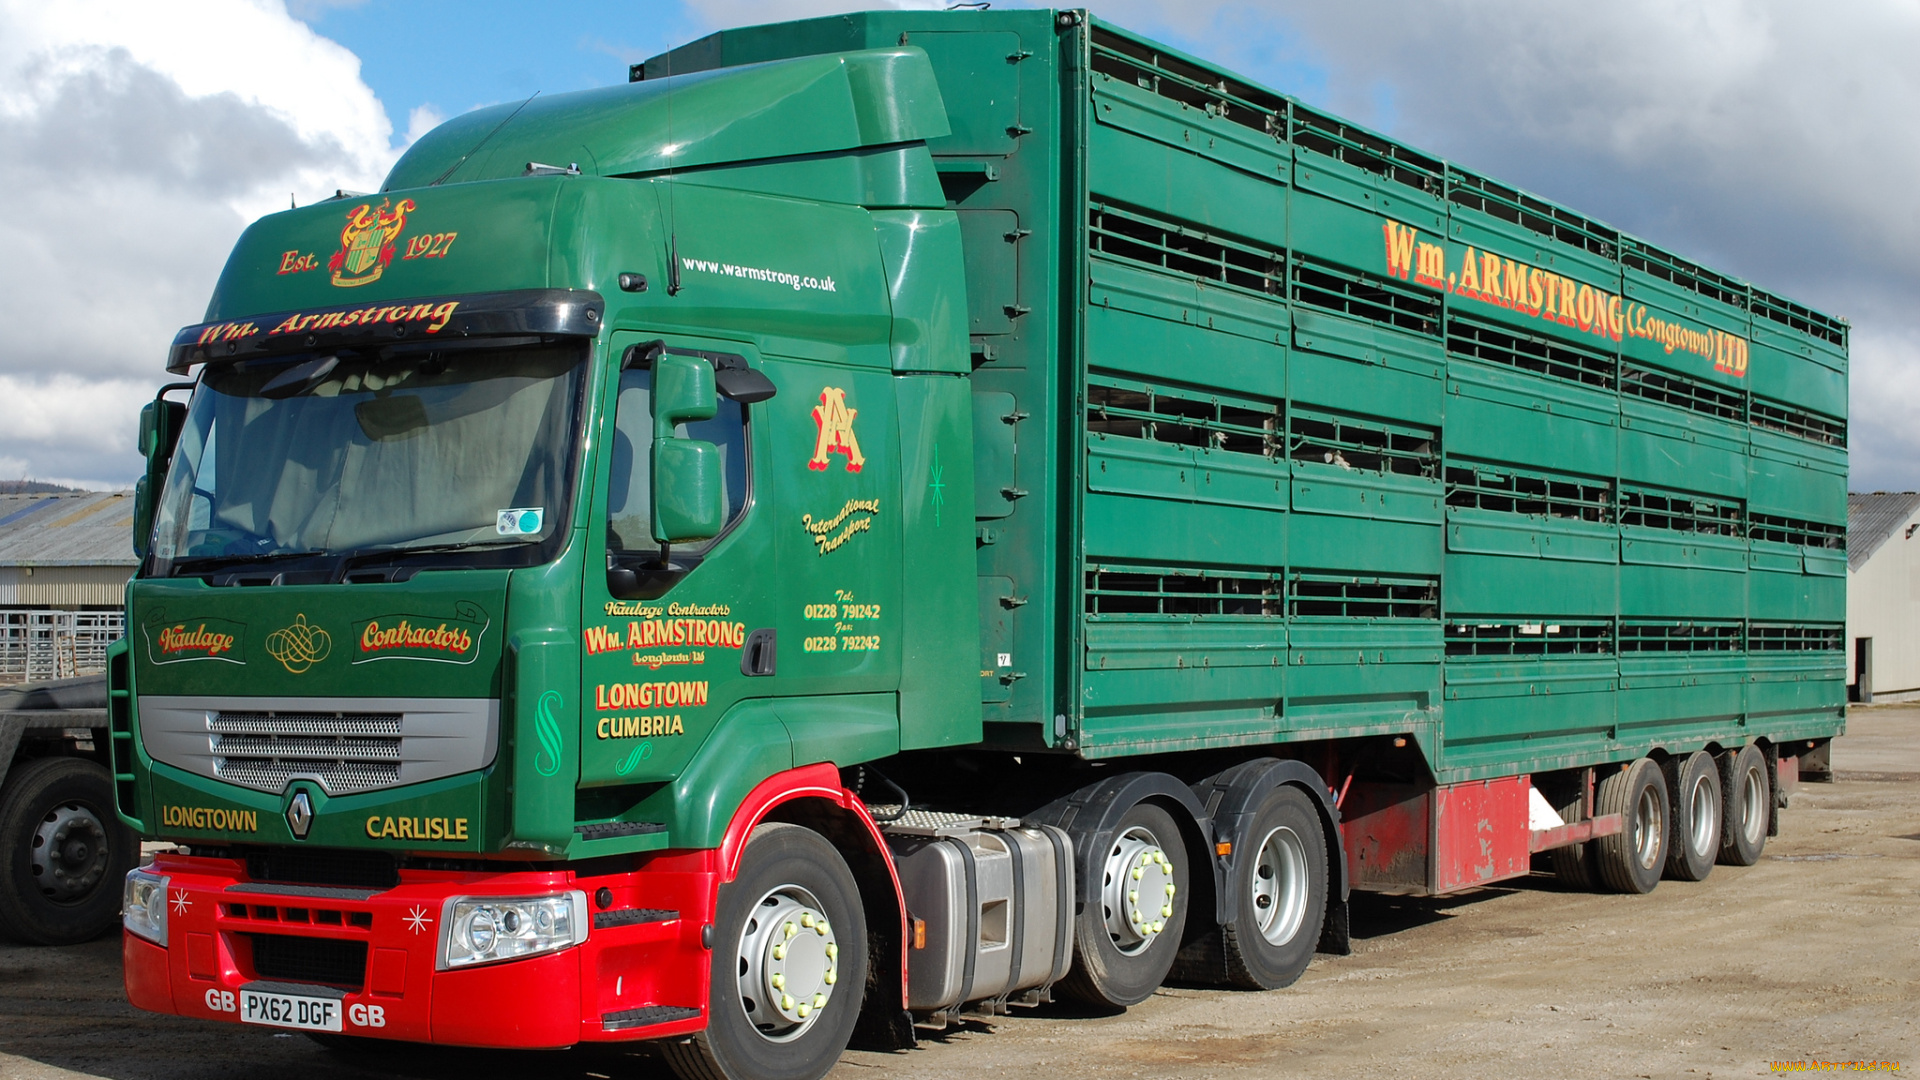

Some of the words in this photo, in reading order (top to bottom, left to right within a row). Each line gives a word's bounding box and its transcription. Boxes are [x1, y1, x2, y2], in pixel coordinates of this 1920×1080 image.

[277, 250, 319, 275] Est.
[403, 232, 458, 260] 1927
[682, 257, 836, 292] www.warmstrong.co.uk
[1383, 219, 1456, 293] Wm.
[1456, 246, 1625, 342] ARMSTRONG
[1626, 302, 1714, 361] (Longtown)
[1714, 330, 1749, 378] LTD
[199, 321, 260, 347] Wm.
[269, 301, 460, 334] Armstrong
[802, 498, 879, 536] International
[815, 516, 871, 558] Transport
[604, 601, 663, 619] Haulage
[667, 601, 730, 617] Contractors
[803, 603, 838, 621] 01228
[841, 604, 881, 621] 791242
[158, 623, 234, 655] Haulage
[360, 620, 472, 654] Contractors
[626, 618, 746, 649] ARMSTRONG
[803, 635, 838, 653] 01228
[841, 635, 881, 652] 792242
[596, 680, 709, 711] LONGTOWN
[596, 714, 684, 740] CUMBRIA
[162, 804, 257, 832] LONGTOWN
[365, 816, 469, 841] CARLISLE
[205, 988, 236, 1013] GB
[248, 994, 293, 1023] PX62
[298, 1001, 334, 1026] DGF
[348, 1003, 386, 1028] GB
